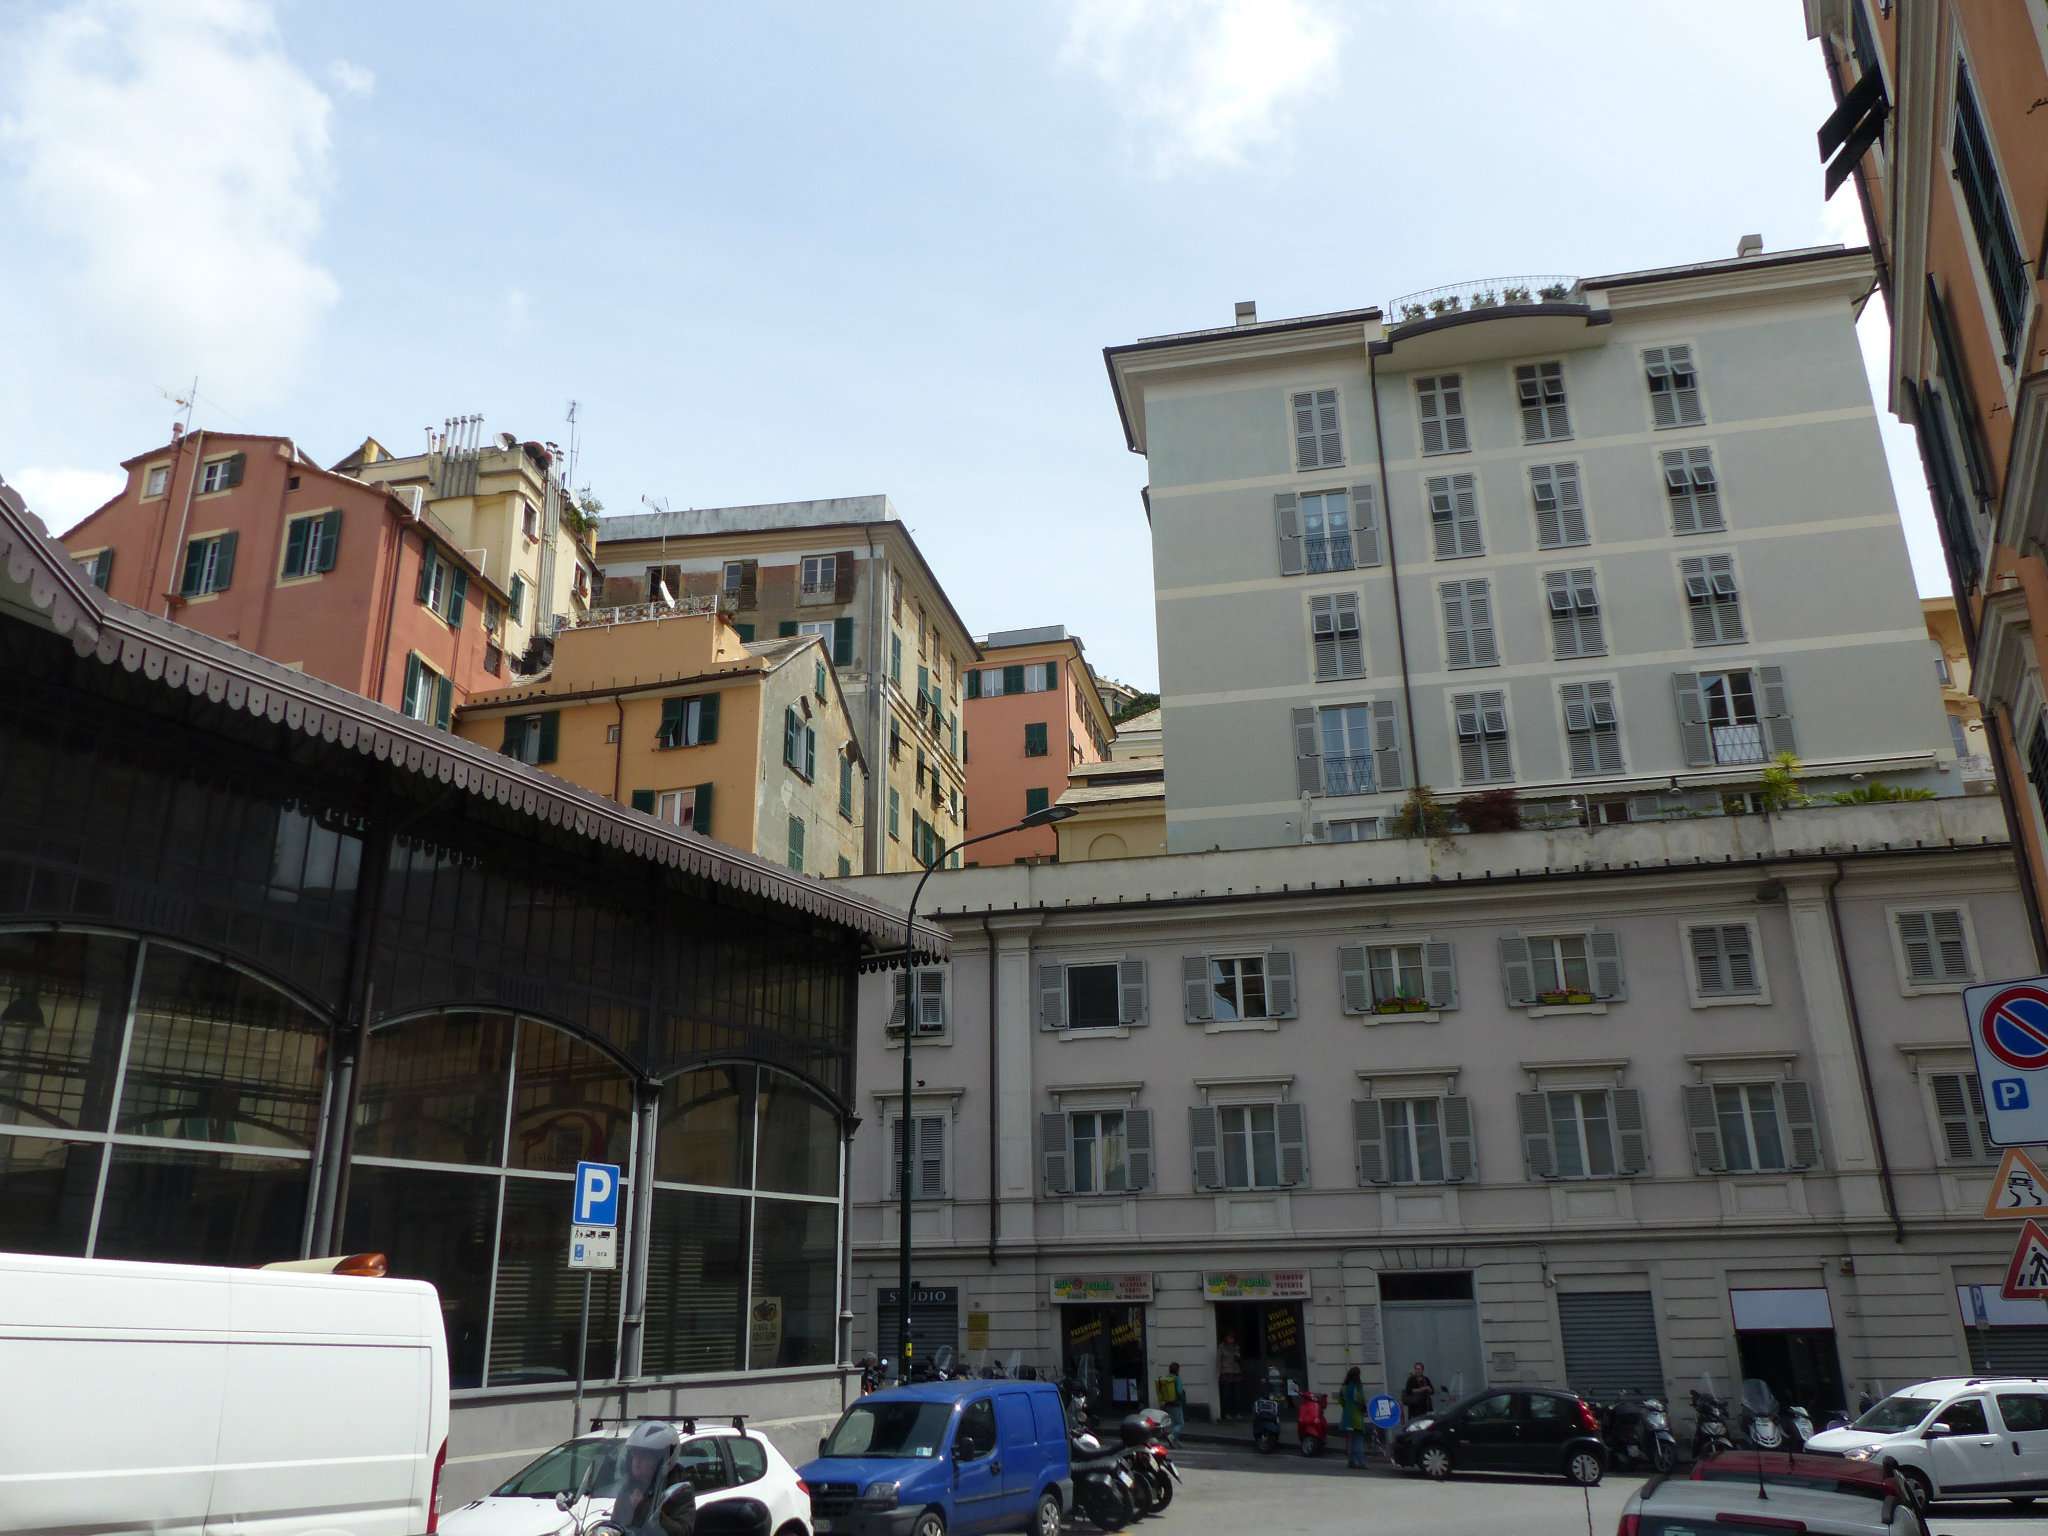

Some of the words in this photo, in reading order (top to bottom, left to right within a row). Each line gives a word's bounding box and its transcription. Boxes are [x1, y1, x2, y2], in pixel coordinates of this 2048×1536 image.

[1999, 1082, 2021, 1107] P
[580, 1167, 612, 1219] P
[889, 1290, 946, 1303] SDIO
